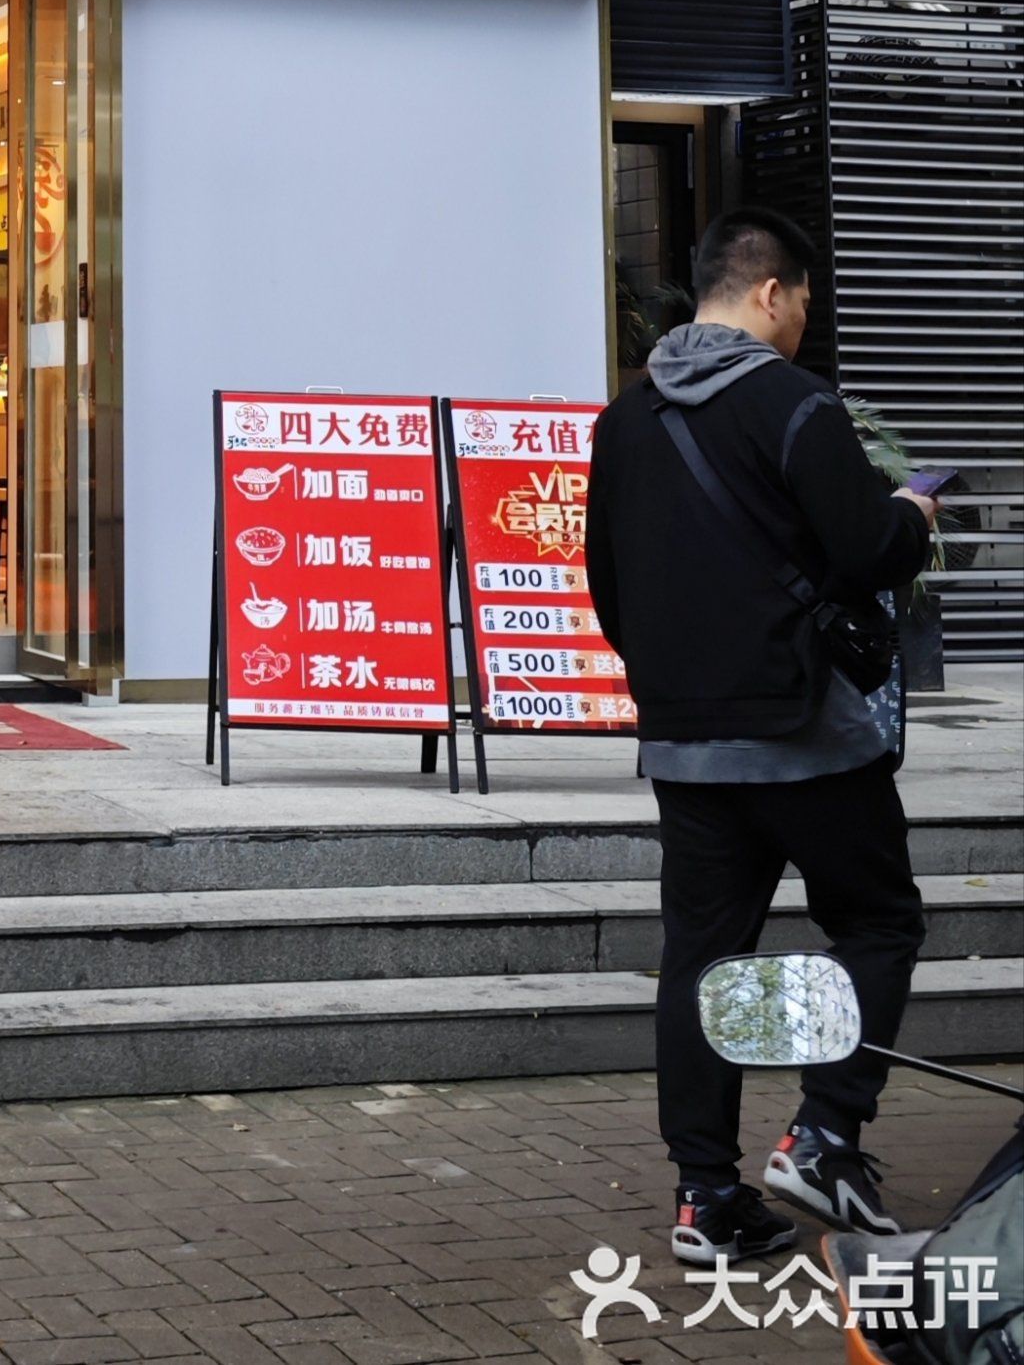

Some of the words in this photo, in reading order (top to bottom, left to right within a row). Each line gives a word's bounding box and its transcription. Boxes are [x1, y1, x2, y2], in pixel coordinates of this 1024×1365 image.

[279, 410, 430, 448] 四大免费
[301, 467, 369, 500] 加面
[528, 471, 589, 503] VIP
[304, 533, 373, 568] 加饭
[498, 568, 543, 587] 100
[549, 567, 560, 591] RMB
[306, 598, 376, 633] 加汤
[503, 610, 550, 630] 200
[554, 608, 565, 634] RMB
[308, 654, 380, 690] 茶水
[508, 653, 556, 672] 500
[559, 651, 570, 676] RMB
[506, 696, 563, 716] 1000
[564, 694, 575, 719] RMB
